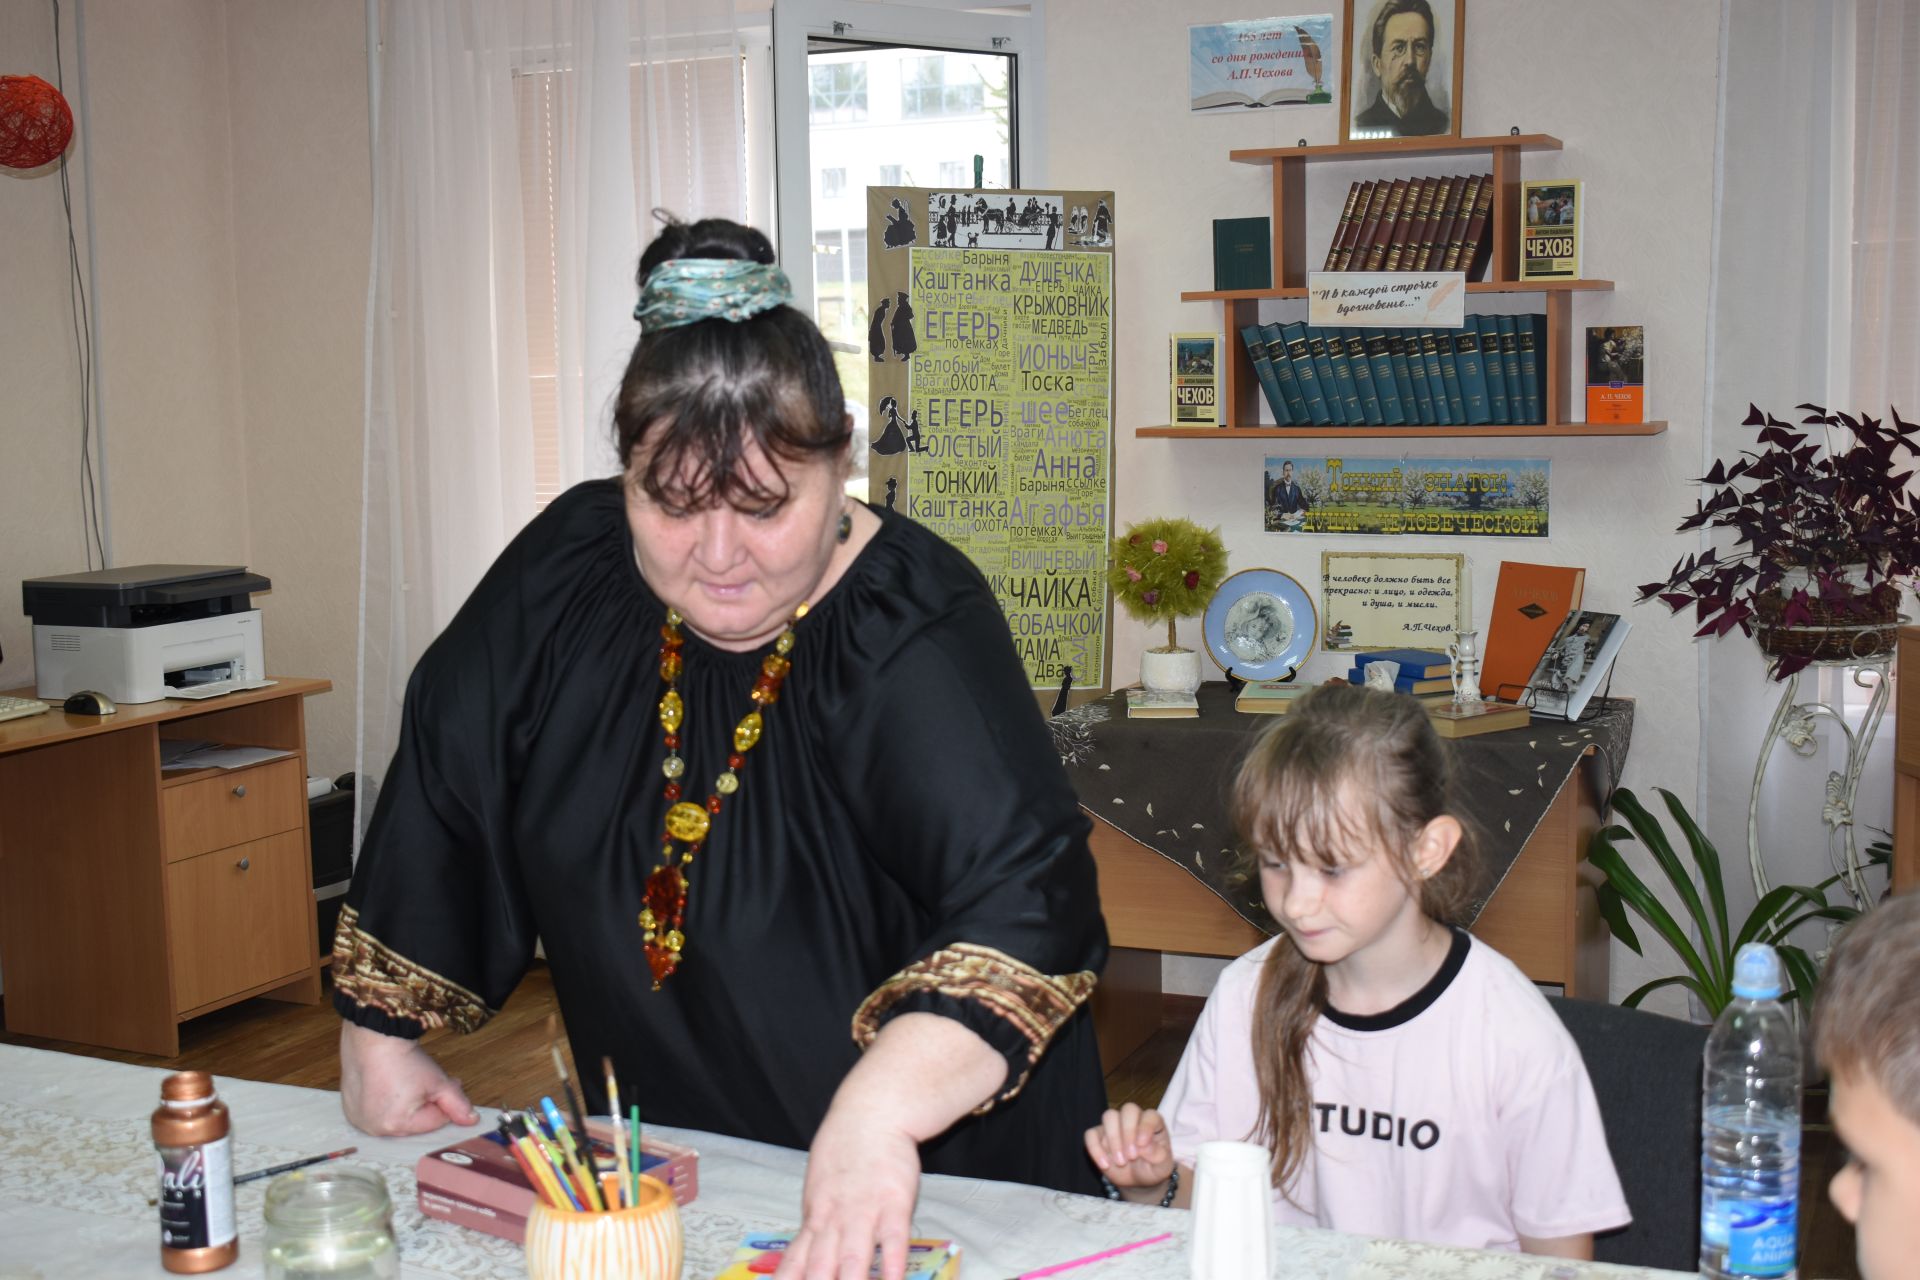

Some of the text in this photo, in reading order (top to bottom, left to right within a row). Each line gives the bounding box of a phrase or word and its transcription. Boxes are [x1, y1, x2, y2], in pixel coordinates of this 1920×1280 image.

[1211, 54, 1224, 64] со
[1226, 51, 1247, 62] дня
[1526, 237, 1573, 257] ЧЕХОВ
[963, 250, 1009, 268] Барыня
[913, 265, 1011, 291] Каштанка
[1020, 261, 1096, 286] ДУШЕЧКА
[917, 288, 974, 305] Чехонте
[1036, 281, 1064, 293] ЕГЕРЬ
[1072, 281, 1102, 297] ЧАЙКА
[1350, 284, 1389, 299] каждой
[1390, 280, 1440, 297] строчке
[1013, 294, 1109, 317] КРЫЖОВНИК
[926, 311, 1000, 341] ЕГЕРЬ
[1032, 318, 1089, 338] МЕДВЕДЬ
[945, 338, 999, 351] потемках
[914, 354, 981, 374] Белобый
[1019, 343, 1088, 370] ИОНЫЧ
[1088, 343, 1099, 377] ТРИ
[915, 374, 951, 391] Враги
[950, 373, 999, 392] ОХОТА
[1021, 370, 1074, 392] Тоска
[1178, 387, 1214, 404] ЧЕХОВ
[928, 399, 1004, 428] ЕГЕРЬ
[1021, 400, 1070, 425] шее
[1068, 405, 1109, 422] Беглец
[921, 429, 1002, 458] ОЛСТЫЙ
[1010, 425, 1044, 442] Враги
[1044, 425, 1107, 449] Анюта
[1032, 448, 1097, 478] Анна
[923, 464, 998, 494] ТОНКИЙ
[1019, 477, 1065, 496] Барыня
[1424, 473, 1508, 493] ЗНАТОК
[909, 495, 1008, 518] Каштанка
[1009, 495, 1105, 535] Агафья
[975, 519, 1009, 532] ОХОТА
[1302, 505, 1539, 534] ДУШИ ЧЕЛОВЕЧЕСКОЙ
[1010, 526, 1064, 539] потемках
[1011, 544, 1097, 570] ВИШНЕВЫЙ
[1010, 568, 1092, 608] ЧАЙКА
[1323, 574, 1451, 585] В человеке должно быть все
[1324, 588, 1372, 597] прекрасно:
[1382, 588, 1406, 598] лицо,
[1417, 588, 1453, 597] одежда,
[1370, 599, 1395, 609] душа,
[1405, 601, 1438, 609] мысли.
[1008, 607, 1103, 636] СОБАЧКОЙ
[1035, 659, 1065, 682] Два
[1311, 1102, 1441, 1151] TUDIO
[163, 1150, 203, 1190] ali
